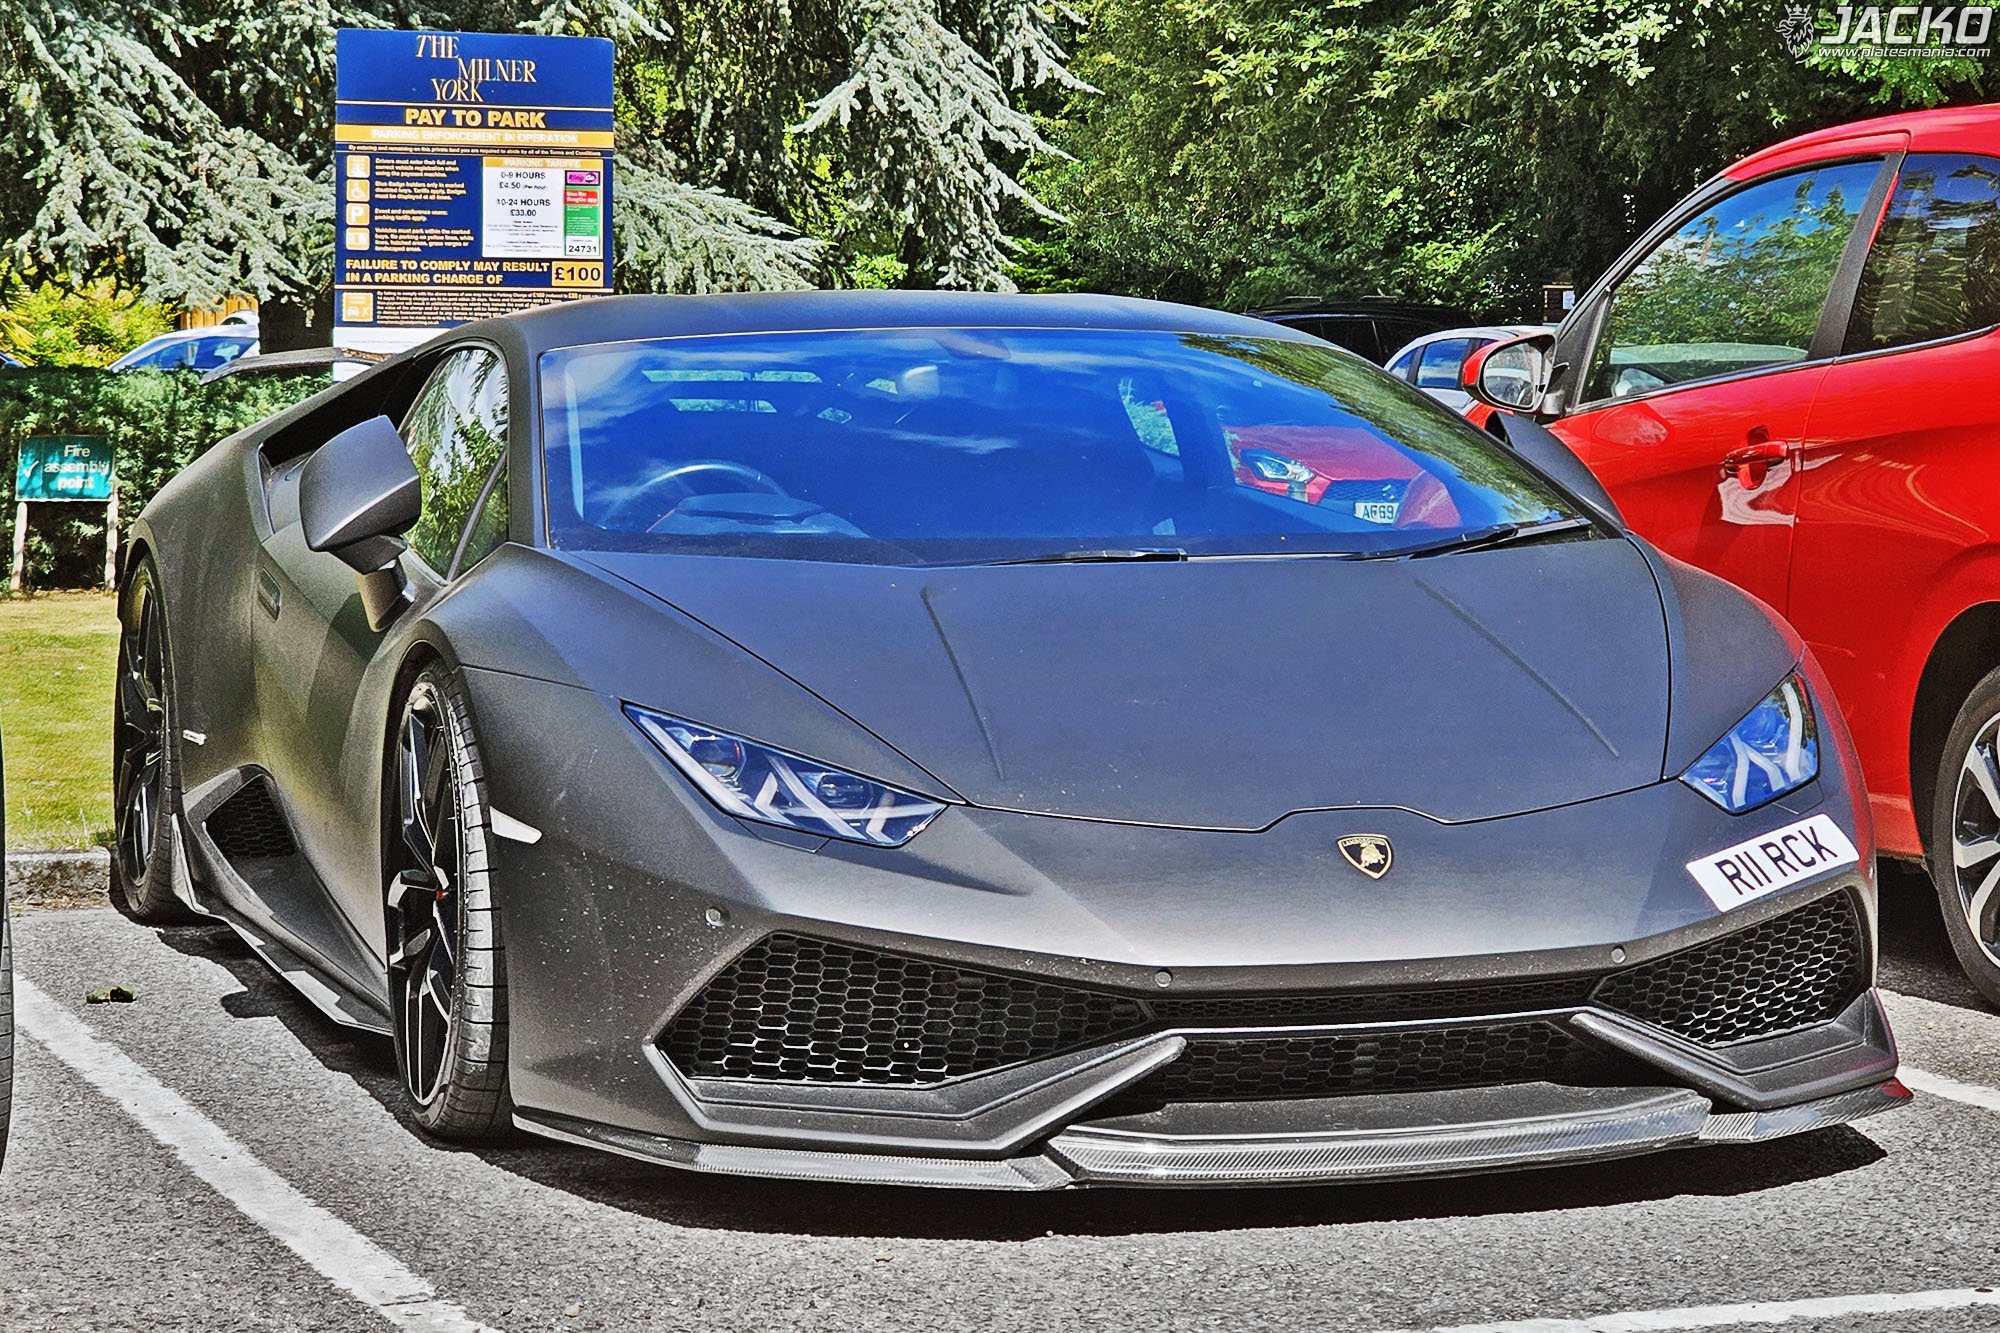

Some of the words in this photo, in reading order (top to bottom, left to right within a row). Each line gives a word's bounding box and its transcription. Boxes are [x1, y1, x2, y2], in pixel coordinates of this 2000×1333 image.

[416, 35, 459, 58] THE
[458, 58, 537, 83] MILNER
[431, 78, 484, 102] YORK
[405, 108, 446, 125] PAY
[452, 109, 482, 126] TO
[488, 111, 546, 128] PARK
[371, 129, 419, 140] PARKING
[421, 130, 501, 142] ENFORCEMENT
[504, 132, 514, 142] IN
[518, 132, 578, 144] OPERATION
[497, 198, 518, 206] 10-24
[510, 209, 537, 217] £33.00
[568, 245, 597, 253] 24731
[345, 259, 398, 270] FAILURE
[399, 260, 418, 270] TO
[420, 260, 471, 271] COMPLY
[473, 261, 500, 271] MAY
[503, 262, 550, 272] RESULT
[345, 272, 360, 282] IN
[362, 273, 373, 283] A
[375, 273, 430, 284] PARKING
[433, 274, 484, 284] CHARGE
[486, 275, 503, 284] OF
[554, 267, 601, 281] £100
[63, 445, 90, 457] Fire
[44, 461, 110, 476] assembly
[57, 477, 94, 490] point
[1362, 504, 1394, 520] AF69
[1714, 851, 1773, 896] R11
[1759, 826, 1838, 878] RCK
